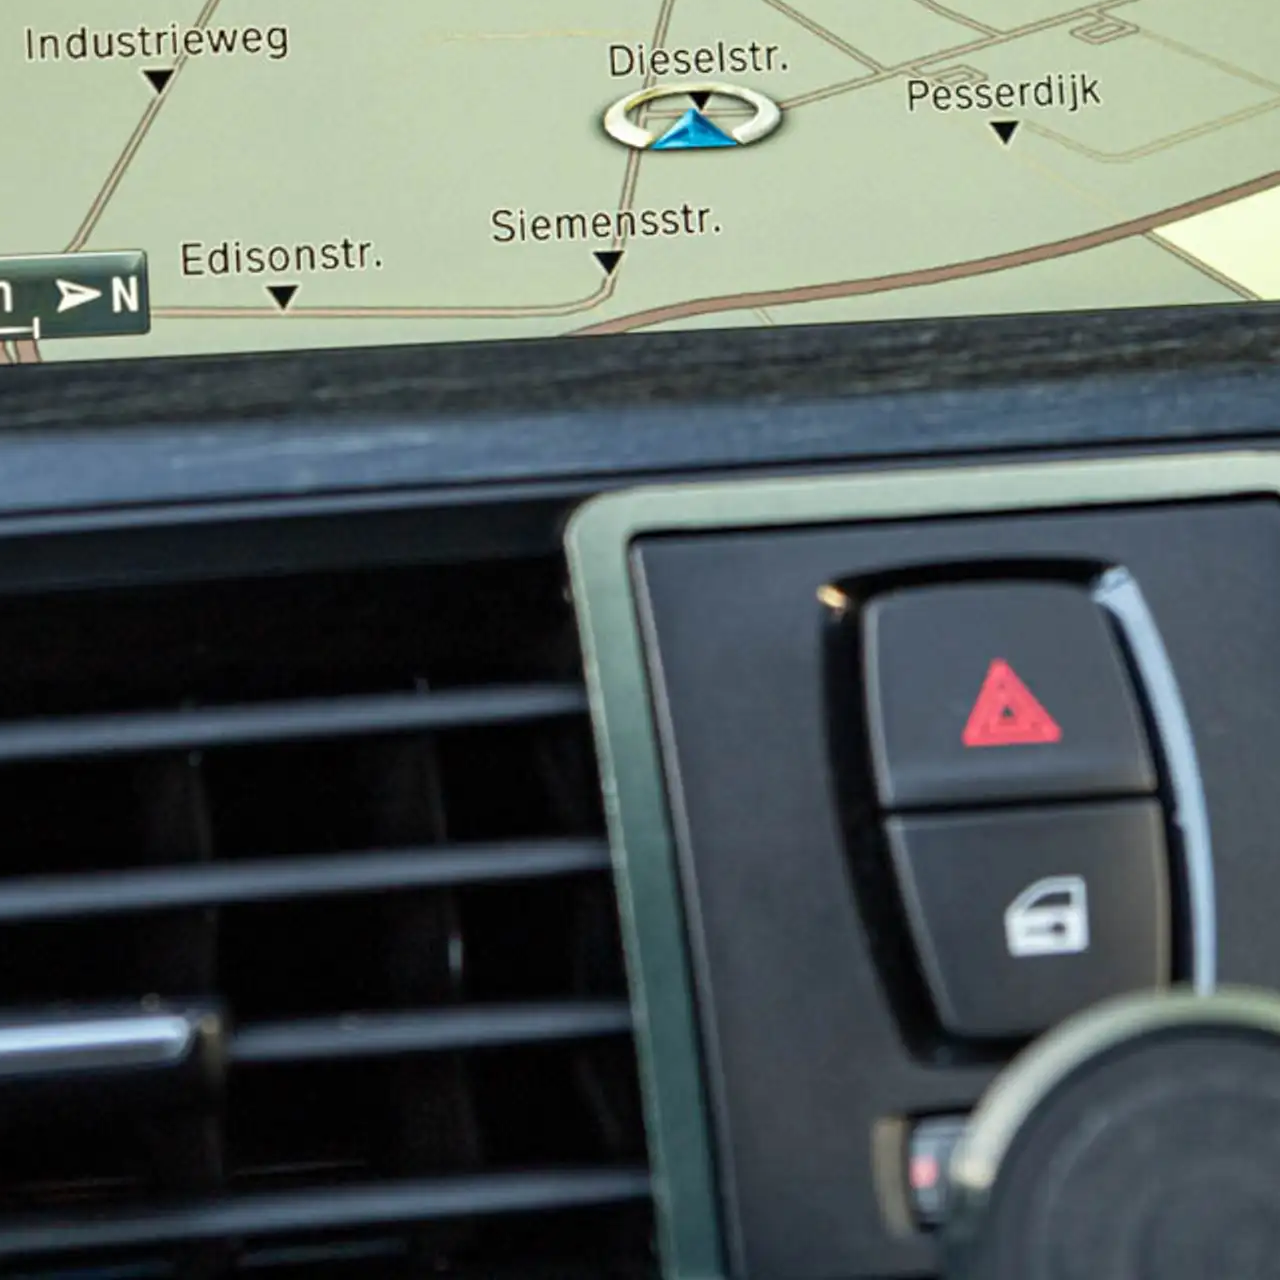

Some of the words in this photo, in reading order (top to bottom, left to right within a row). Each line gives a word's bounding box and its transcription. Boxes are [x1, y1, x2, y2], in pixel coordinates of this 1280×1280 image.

[25, 23, 290, 62] Industrieweg
[608, 40, 790, 79] Dieselstr.
[907, 73, 1101, 114] Pesserdijk
[491, 203, 723, 245] Siemensstr.
[181, 238, 384, 278] Edisonstr.
[112, 275, 139, 313] N
